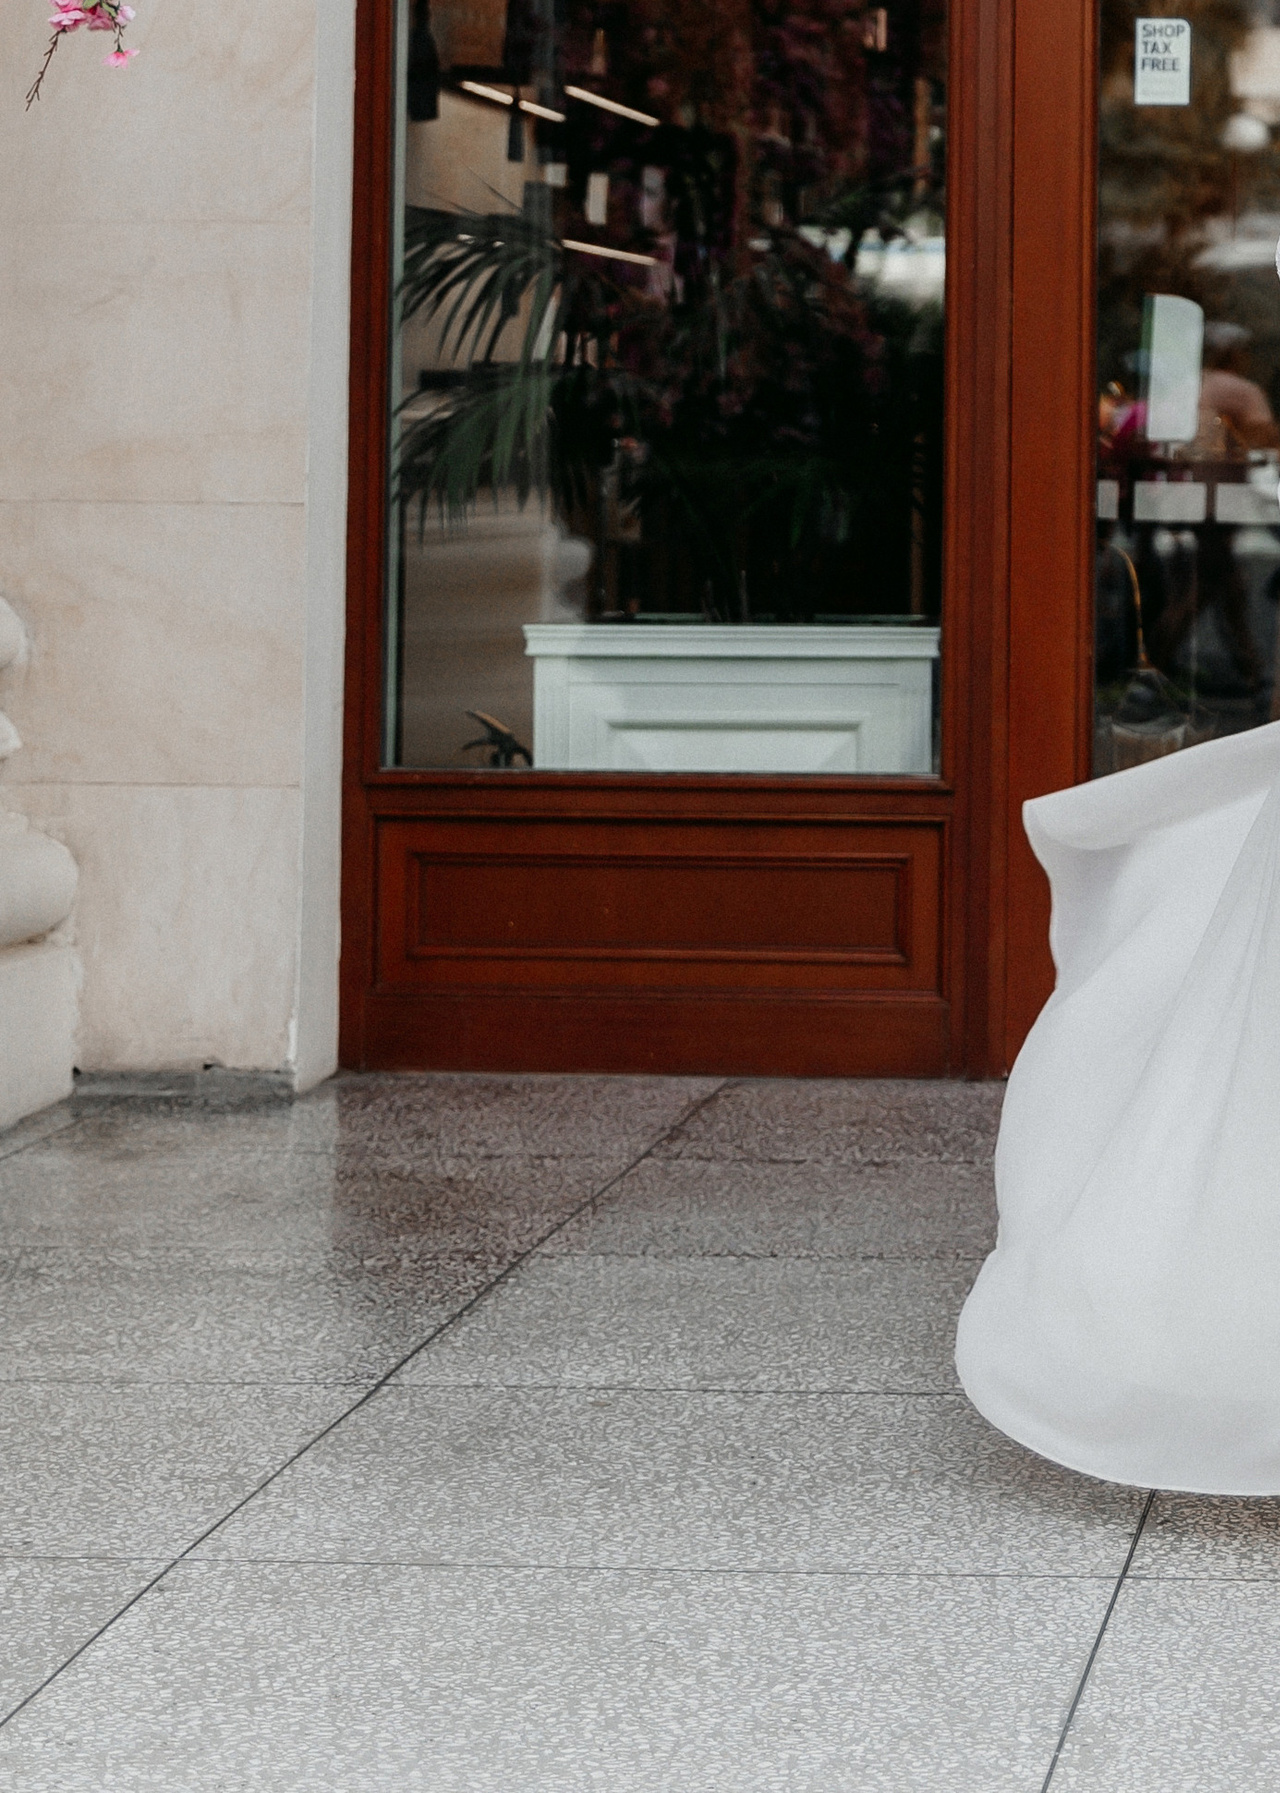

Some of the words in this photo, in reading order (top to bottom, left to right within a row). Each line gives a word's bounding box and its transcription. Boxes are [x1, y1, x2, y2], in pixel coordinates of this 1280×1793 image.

[1142, 24, 1186, 38] SHOP
[1142, 41, 1173, 54] TAX
[1141, 58, 1180, 71] FREE
